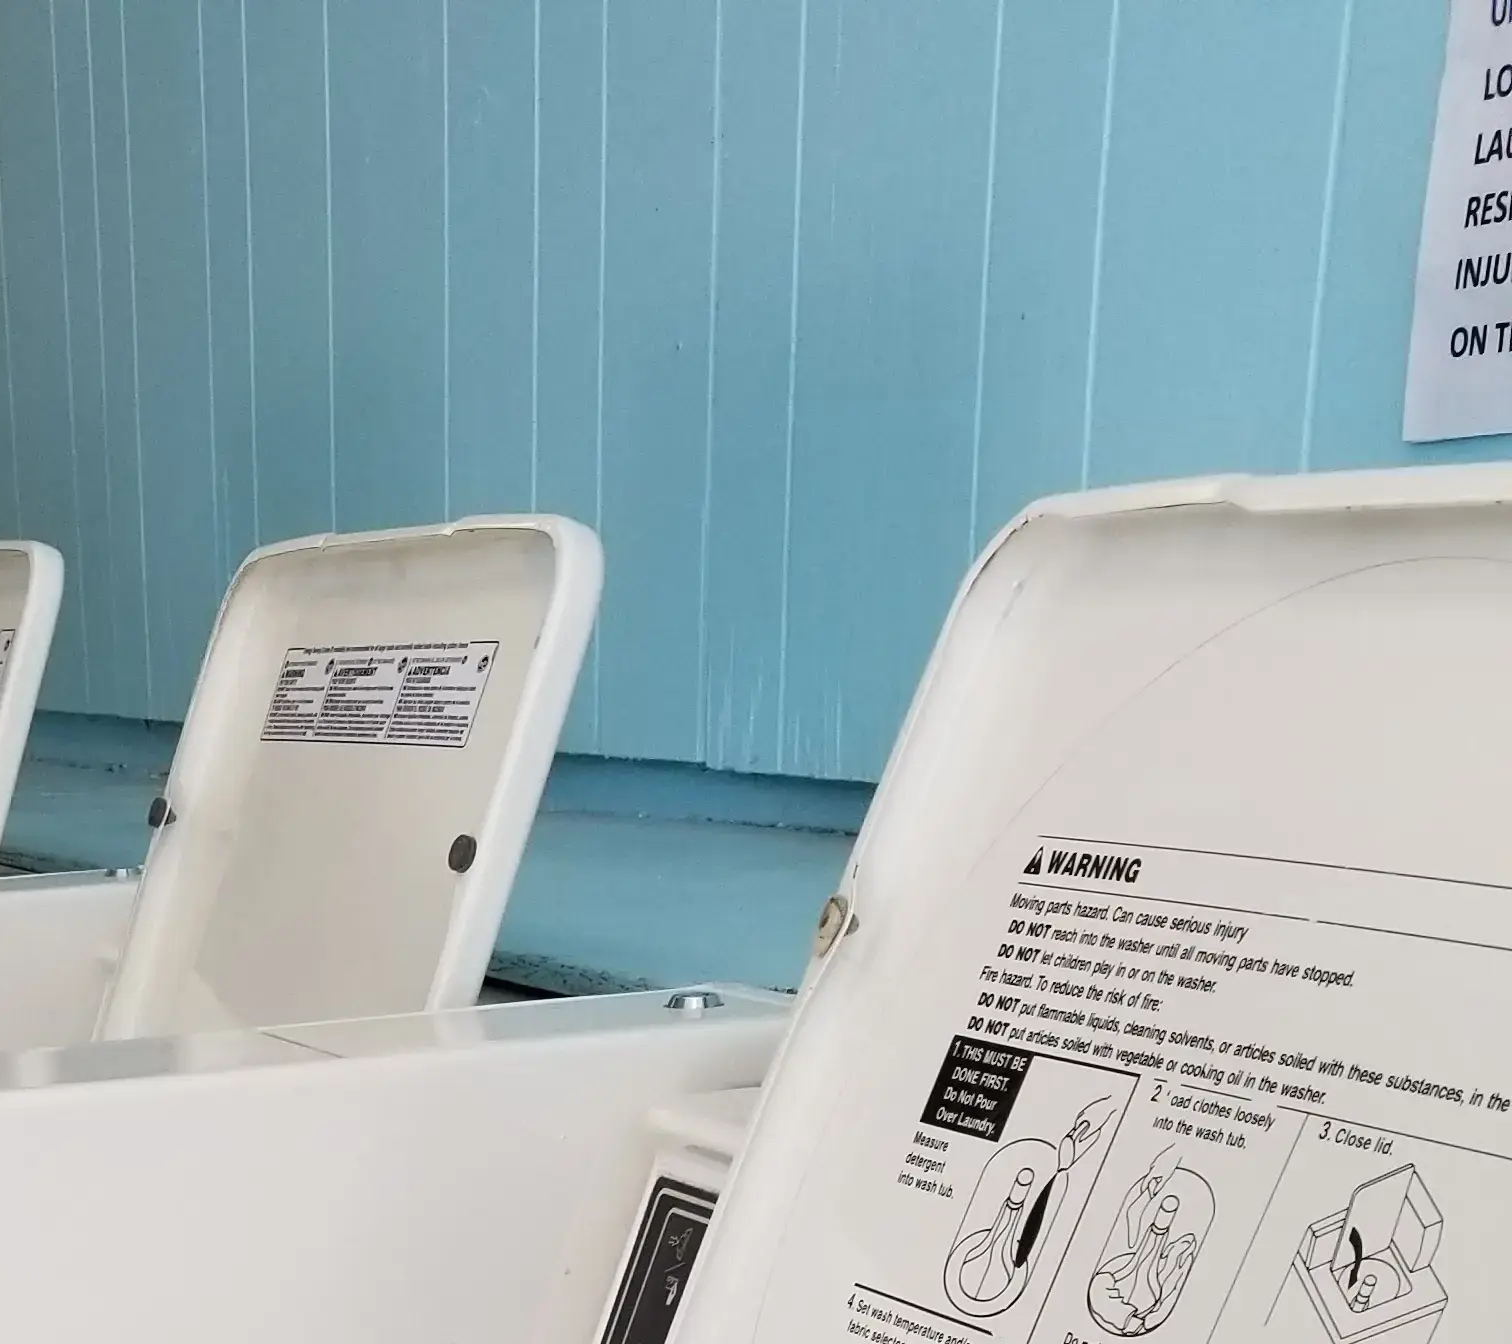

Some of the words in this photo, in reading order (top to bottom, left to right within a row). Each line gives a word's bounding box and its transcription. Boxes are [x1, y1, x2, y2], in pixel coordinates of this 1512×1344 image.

[1464, 191, 1512, 229] RES
[1450, 323, 1488, 359] ON
[1495, 319, 1512, 353] T
[1047, 850, 1142, 883] WARNING
[1010, 893, 1045, 915] Moving
[1046, 900, 1072, 918] parts
[1075, 901, 1109, 920] hazard.
[1112, 906, 1133, 923] Can
[1136, 913, 1168, 928] cause
[1170, 916, 1211, 935] serious
[1214, 920, 1249, 944] injury
[997, 944, 1013, 958] DO
[1017, 948, 1041, 963] NOT
[1040, 950, 1052, 965] let
[1054, 953, 1091, 971] children
[1093, 961, 1115, 979] play
[1116, 962, 1126, 977] in
[1128, 966, 1140, 979] or
[1141, 969, 1155, 982] on
[1157, 970, 1174, 985] the
[1177, 974, 1216, 993] washer.
[1008, 919, 1024, 934] DO
[1027, 922, 1051, 938] NOT
[1051, 927, 1077, 943] reach
[1079, 930, 1098, 945] into
[1100, 933, 1116, 948] the
[1118, 937, 1153, 955] washer
[1155, 943, 1177, 957] until
[1180, 946, 1195, 961] all
[1195, 949, 1237, 972] moving
[1236, 956, 1268, 973] parts
[1270, 959, 1299, 978] have
[1302, 965, 1355, 987] stopped.
[980, 965, 996, 983] Fire
[999, 968, 1033, 988] hazard.
[1036, 975, 1048, 991] To
[1050, 977, 1084, 998] reduce
[1086, 984, 1103, 1001] the
[1104, 988, 1123, 1005] risk
[1127, 991, 1142, 1007] of
[952, 1040, 960, 1057] 1.
[960, 1045, 983, 1062] THIS
[983, 1050, 1012, 1068] MUST
[1011, 1056, 1028, 1071] BE
[967, 1015, 983, 1031] DO
[985, 1020, 1010, 1037] NOT
[1009, 1025, 1025, 1042] put
[1026, 1029, 1059, 1048] articles
[1061, 1037, 1092, 1054] soiled
[1092, 1042, 1114, 1059] with
[1115, 1047, 1164, 1070] vegetable
[1166, 1057, 1178, 1072] or
[1180, 1061, 1224, 1085] cooking
[1227, 1068, 1243, 1085] oil
[1244, 1073, 1256, 1088] in
[1258, 1077, 1277, 1093] the
[1281, 1084, 1326, 1105] washer.
[977, 992, 995, 1007] DO
[996, 997, 1021, 1013] NOT
[1018, 1003, 1036, 1020] put
[1037, 1004, 1085, 1025] flammable
[1088, 1013, 1120, 1035] liquids,
[1123, 1022, 1167, 1045] cleaning
[1168, 1029, 1215, 1053] solvents,
[1219, 1041, 1232, 1055] or
[1234, 1042, 1276, 1064] articles
[1277, 1053, 1318, 1071] soiled
[1318, 1058, 1344, 1077] with
[1347, 1063, 1383, 1085] these
[1386, 1072, 1464, 1104] substances,
[1469, 1088, 1484, 1106] in
[1487, 1093, 1510, 1112] the
[952, 1067, 980, 1085] DONE
[980, 1072, 1010, 1091] FIRST.
[944, 1087, 956, 1101] Do
[958, 1090, 975, 1103] Not
[976, 1094, 998, 1110] Pour
[936, 1107, 958, 1121] Over
[957, 1112, 995, 1136] Laundry.
[1192, 1099, 1231, 1119] clothes
[1234, 1106, 1276, 1132] loosely
[913, 1131, 949, 1152] Measure
[1153, 1117, 1173, 1131] into
[1176, 1120, 1192, 1135] the
[1195, 1127, 1224, 1144] wash
[1226, 1131, 1246, 1149] tub.
[1318, 1121, 1331, 1142] 3.
[1334, 1128, 1372, 1150] Close
[1373, 1136, 1393, 1156] lid.
[905, 1152, 946, 1173] detergent
[897, 1171, 914, 1187] into
[915, 1176, 937, 1193] wash
[938, 1184, 954, 1199] tub.
[847, 1293, 856, 1309] 4.
[857, 1300, 870, 1315] Set
[871, 1308, 892, 1322] wash
[893, 1314, 944, 1343] temperature
[847, 1319, 870, 1339] fabric
